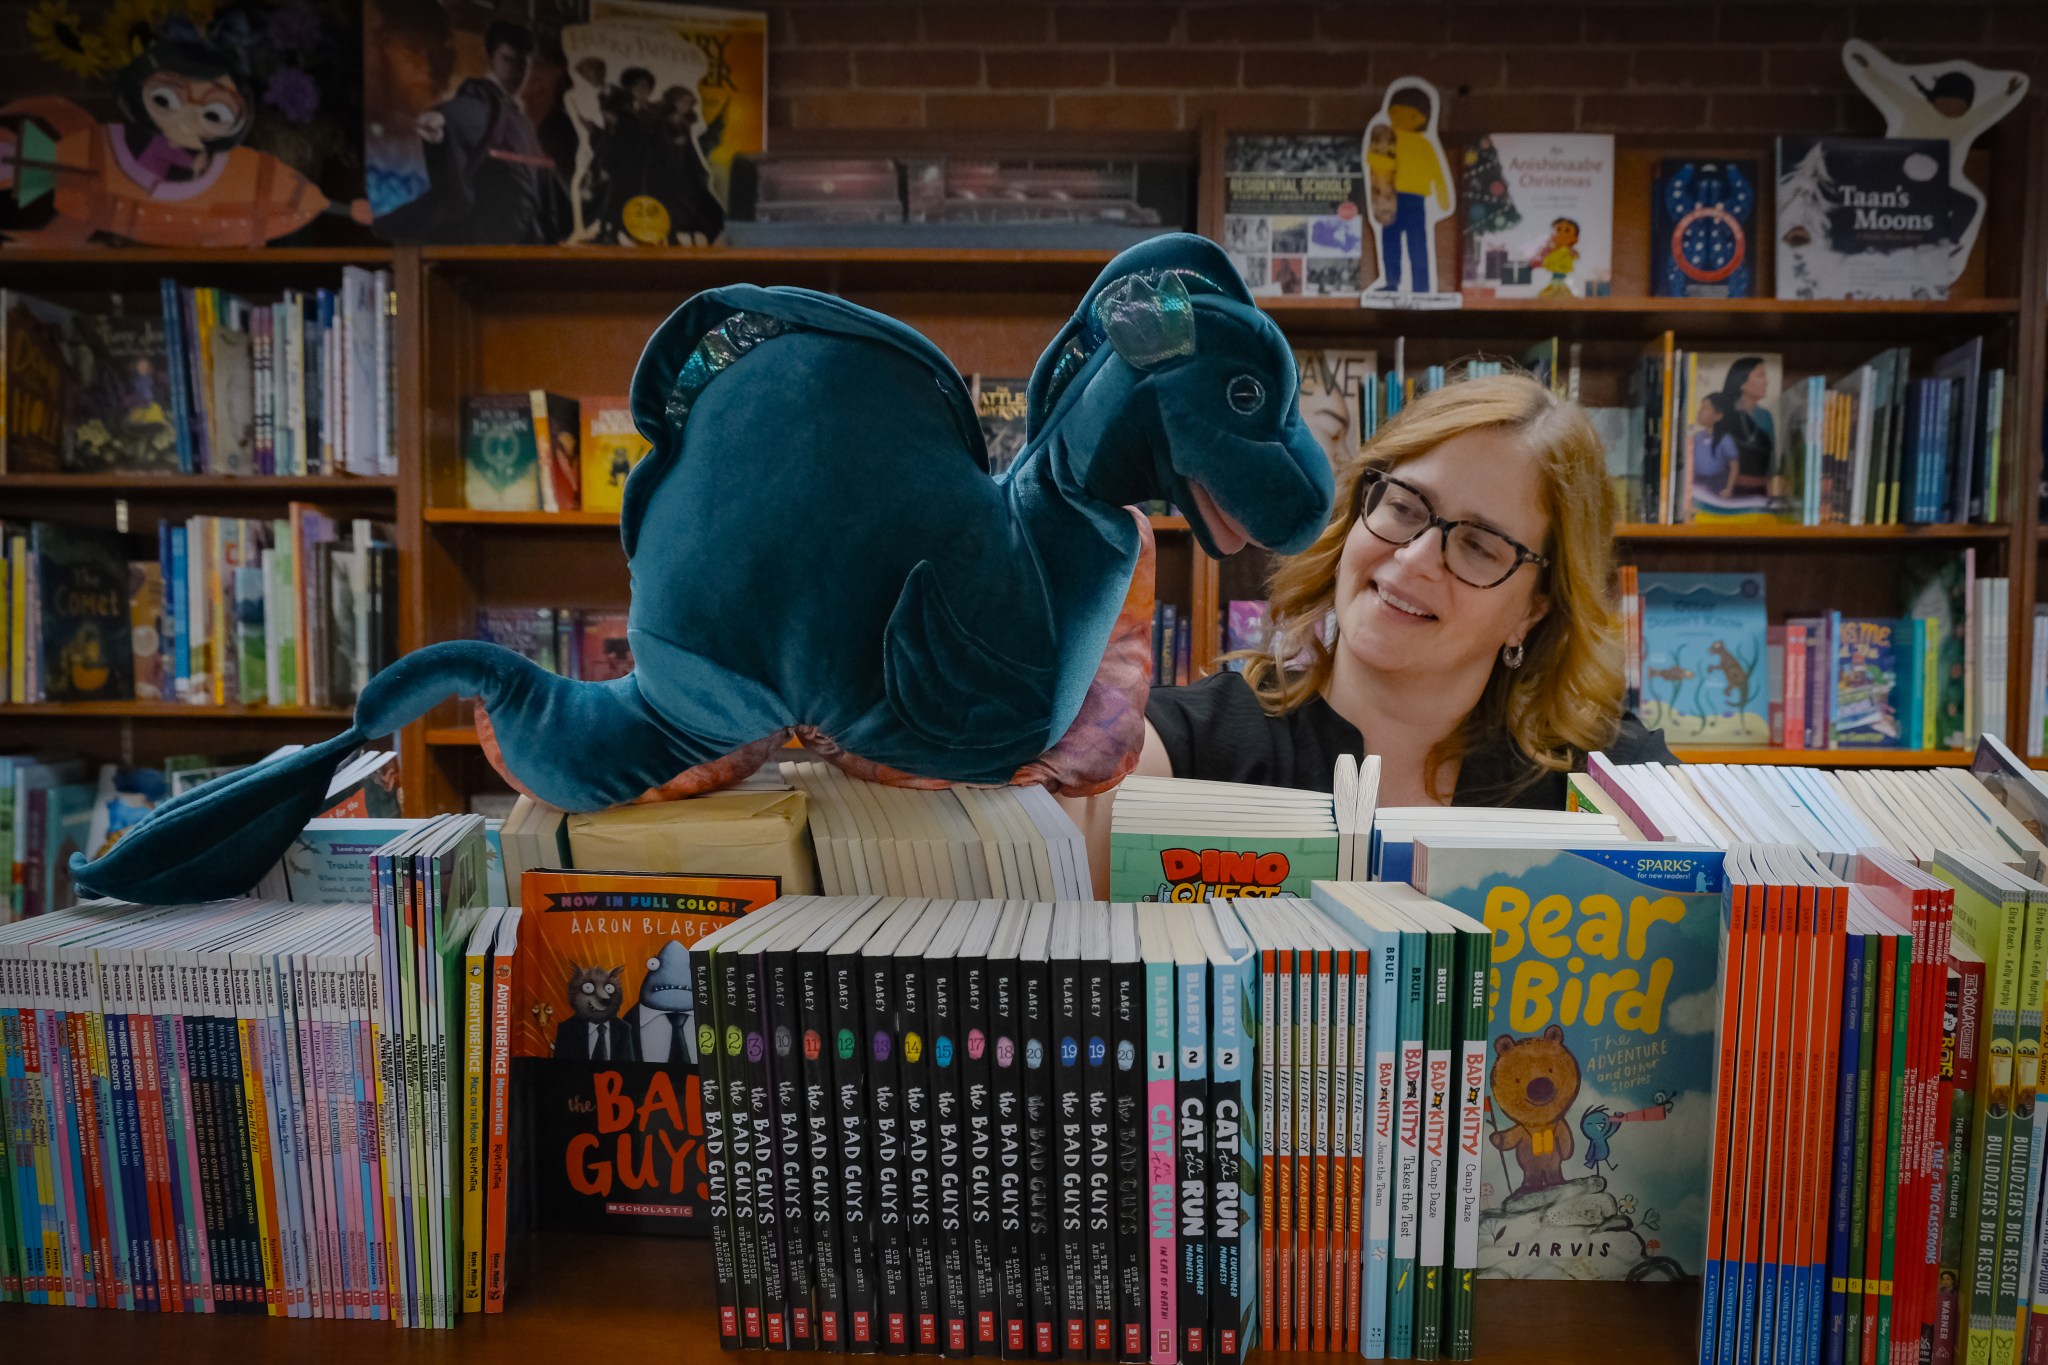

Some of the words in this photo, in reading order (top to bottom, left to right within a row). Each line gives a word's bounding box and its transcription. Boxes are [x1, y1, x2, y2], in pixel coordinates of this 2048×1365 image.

[1510, 158, 1603, 171] Anishinaabe
[1519, 173, 1591, 188] Christmas
[1838, 184, 1910, 208] Taan's
[1854, 208, 1933, 230] Moons
[326, 860, 365, 870] Trouble
[1160, 848, 1290, 886] DINO
[1637, 859, 1692, 872] SPARKS
[1661, 872, 1691, 880] readers!
[560, 895, 599, 908] NOW
[606, 896, 624, 908] IN
[630, 896, 670, 909] FULL
[676, 899, 737, 913] COLOR!
[1170, 883, 1282, 904] QUEST
[571, 917, 632, 934] AARON
[643, 917, 723, 937] BLABEY
[1482, 886, 1687, 963] Bear
[2008, 907, 2019, 923] Elise
[1918, 920, 1927, 964] Bambridge
[2007, 925, 2017, 950] Broach
[1385, 947, 1395, 984] BRUEL
[1967, 974, 1976, 986] THE
[2005, 960, 2015, 978] Kelly
[697, 966, 708, 1006] BLABEY
[775, 967, 785, 1007] BLABEY
[969, 970, 980, 1010] BLABEY
[1063, 977, 1073, 1018] BLABEY
[1411, 967, 1421, 1003] BRUEL
[1473, 971, 1484, 1008] BRUEL
[1510, 957, 1674, 1034] Bird
[2000, 980, 2013, 1006] Murphy
[1155, 975, 1168, 1039] BLABEY
[1186, 973, 1200, 1036] BLABEY
[1961, 988, 1977, 1031] BOXCAR
[468, 982, 480, 1073] ADVENTUREMICE
[494, 983, 509, 1075] ADVENTUREMICE
[700, 1031, 713, 1048] 2
[776, 1034, 790, 1048] 10
[107, 1031, 116, 1057] INSIDE
[968, 1037, 983, 1051] 17
[1061, 1044, 1078, 1059] 19
[1189, 1051, 1198, 1063] 2
[1587, 1039, 1668, 1072] ADVENTURE
[1591, 1034, 1631, 1052] The
[1961, 1028, 1972, 1059] CHILDREN
[111, 1058, 120, 1090] SCOUTS
[1158, 1055, 1164, 1069] 1
[1379, 1062, 1392, 1087] BAD
[1404, 1048, 1422, 1081] BAD
[1466, 1054, 1484, 1087] BAD
[1597, 1067, 1620, 1082] and
[1960, 1070, 1967, 1079] #1
[470, 1077, 479, 1095] MICE
[703, 1079, 719, 1105] the
[779, 1081, 795, 1106] the
[970, 1083, 988, 1110] the
[1263, 1070, 1272, 1113] HELPER
[568, 1098, 599, 1113] the
[593, 1070, 704, 1136] BA
[1062, 1091, 1080, 1118] the
[469, 1122, 478, 1143] MOON
[705, 1111, 724, 1154] BAD
[1151, 1104, 1172, 1158] CAT
[1181, 1098, 1204, 1153] CAT
[1376, 1101, 1390, 1137] KITTY
[1400, 1100, 1419, 1148] KITTY
[1461, 1106, 1480, 1156] KITTY
[1956, 1118, 1964, 1135] THE
[118, 1132, 127, 1150] Kind
[781, 1113, 799, 1156] BAD
[972, 1116, 989, 1160] BAD
[1063, 1124, 1081, 1167] BAD
[1263, 1132, 1273, 1155] DAY
[1184, 1149, 1196, 1179] the
[1195, 1158, 1204, 1174] on
[1905, 1147, 1913, 1169] Drum
[1932, 1148, 1945, 1170] TALE
[1953, 1136, 1963, 1169] BOXCAR
[1263, 1163, 1273, 1194] LANA
[1376, 1167, 1385, 1181] the
[1402, 1155, 1416, 1189] Takes
[1462, 1163, 1476, 1194] Camp
[1932, 1171, 1940, 1182] OF
[1982, 1135, 2003, 1217] BULLDOZER'S
[708, 1160, 728, 1217] GUYS
[783, 1162, 802, 1219] GUYS
[972, 1165, 990, 1223] GUYS
[1063, 1173, 1081, 1231] GUYS
[1375, 1182, 1386, 1207] Team
[1401, 1191, 1414, 1211] the
[1930, 1182, 1943, 1201] TWO
[1950, 1171, 1961, 1219] CHILDREN
[618, 1204, 691, 1215] SCHOLASTIC
[1152, 1184, 1174, 1239] RUN
[1181, 1180, 1204, 1236] RUN
[1263, 1196, 1272, 1231] BUTTON
[1463, 1196, 1476, 1223] Daze
[1400, 1214, 1413, 1238] Test
[1925, 1203, 1939, 1265] CLASSROOMS
[1979, 1222, 1996, 1242] BIG
[1185, 1244, 1193, 1283] MADNESS!
[1508, 1241, 1611, 1258] JARVIS
[1160, 1257, 1168, 1274] CAT
[1196, 1254, 1204, 1295] CUCUMBER
[1975, 1248, 1994, 1297] RESCUE
[1161, 1290, 1169, 1320] DEATH!
[1706, 1281, 1715, 1326] CANDLEWICK
[1940, 1300, 1951, 1340] WARNER
[1704, 1328, 1712, 1355] SPARKS
